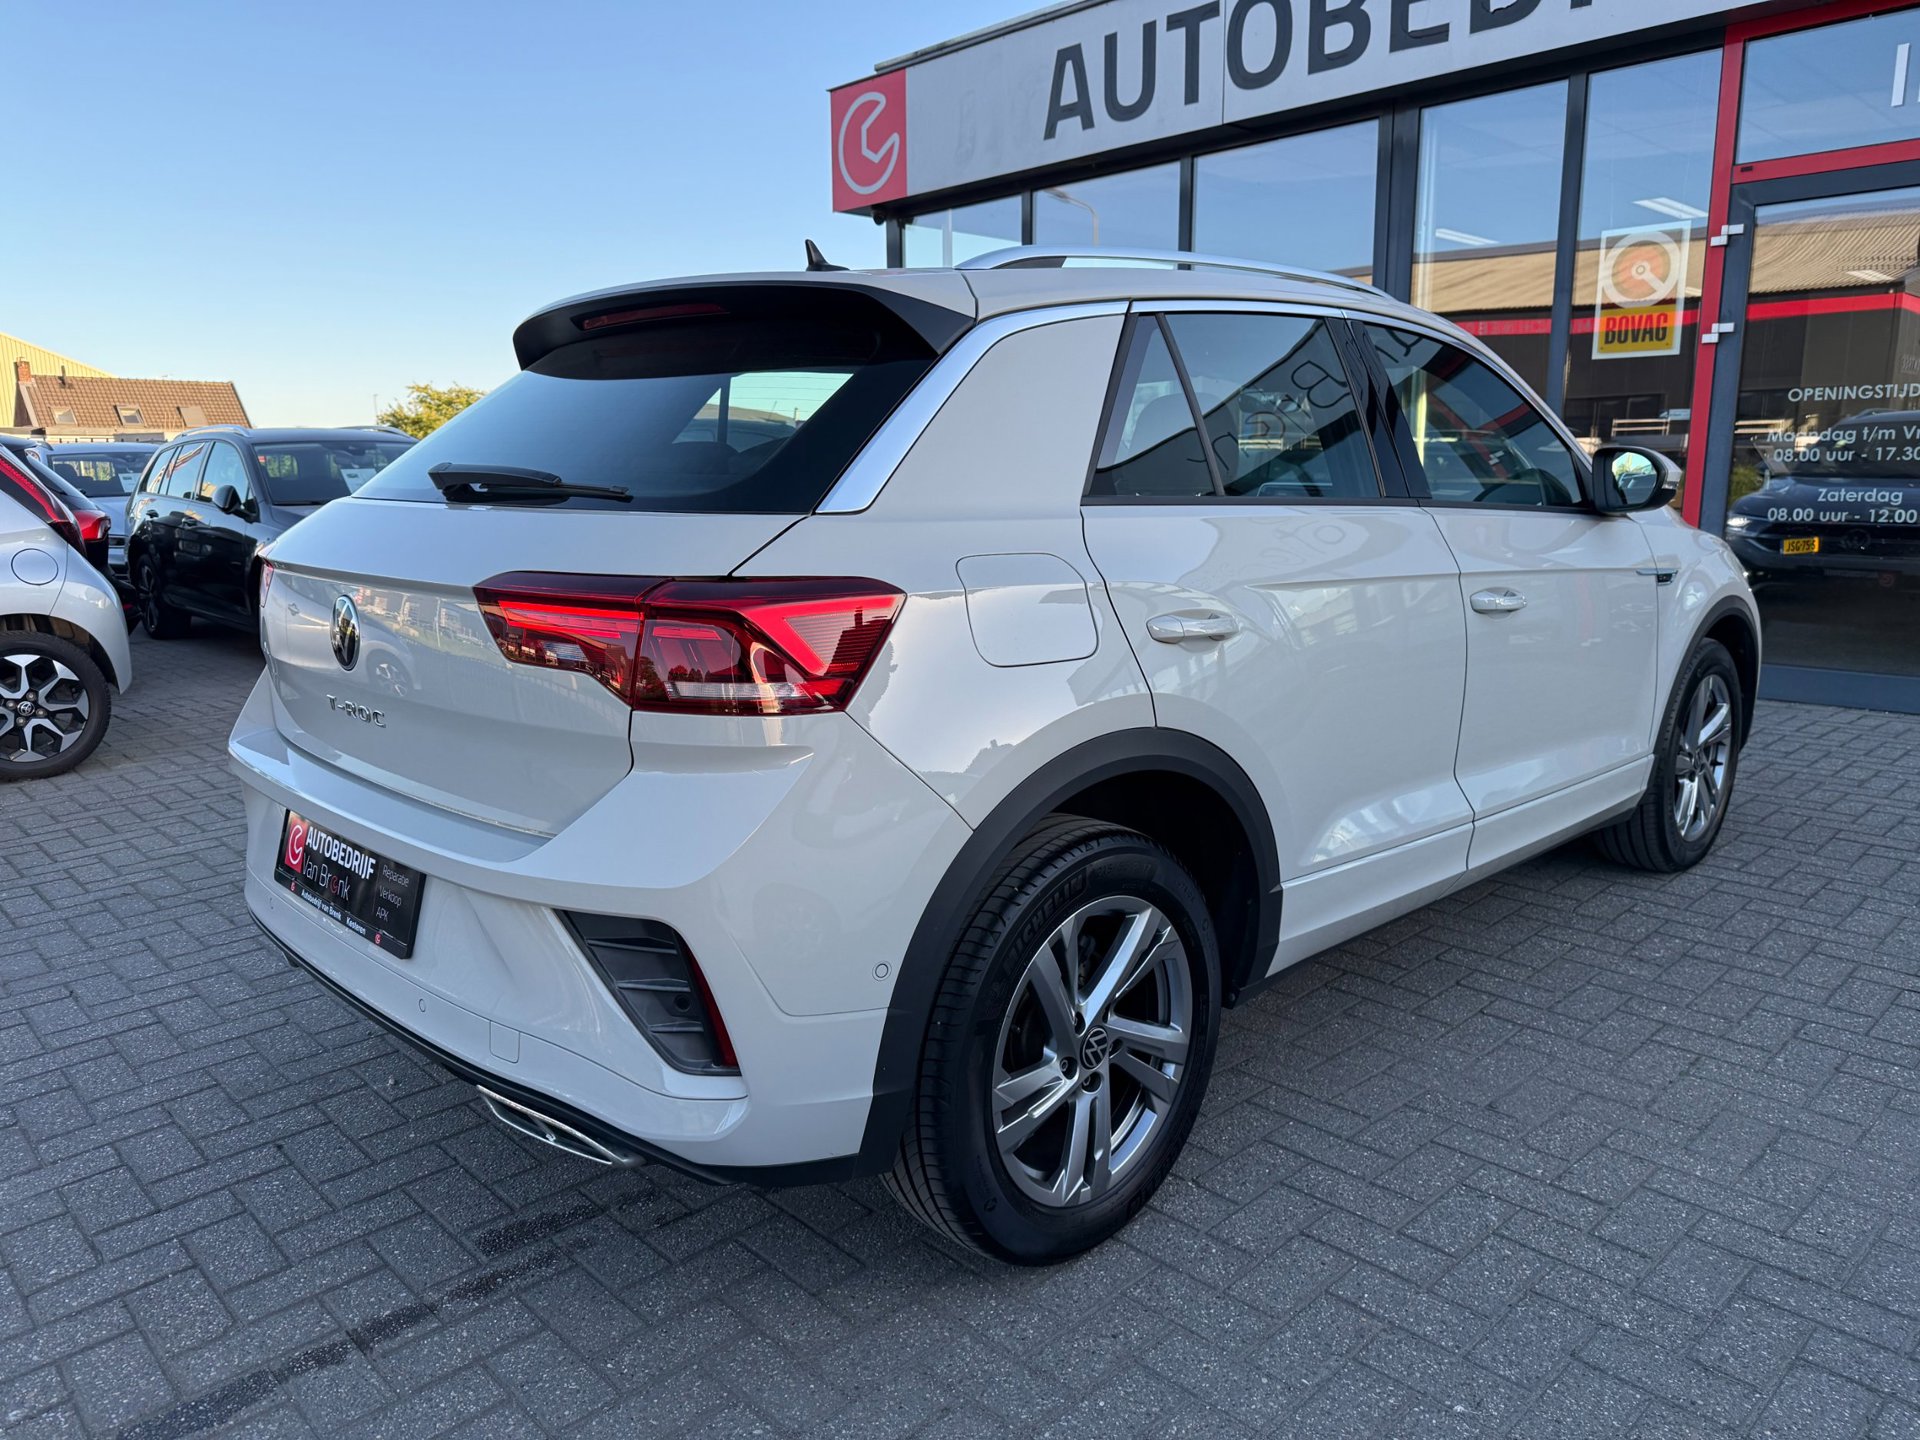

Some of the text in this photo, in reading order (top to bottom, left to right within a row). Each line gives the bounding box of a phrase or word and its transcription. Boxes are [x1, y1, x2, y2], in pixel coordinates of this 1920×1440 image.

[1604, 312, 1668, 345] BOVAG
[1788, 383, 1920, 402] OPENINGSTIJD
[1862, 426, 1896, 442] t/m
[1773, 448, 1820, 462] 08.00
[1826, 451, 1855, 462] uur
[1817, 488, 1903, 505] Zaterdag
[1767, 507, 1814, 522] 08.00
[1819, 511, 1849, 522] uur
[1869, 508, 1918, 523] 12.00
[326, 693, 387, 728] T-ROC
[306, 826, 376, 880] AUTOBEDRIJF
